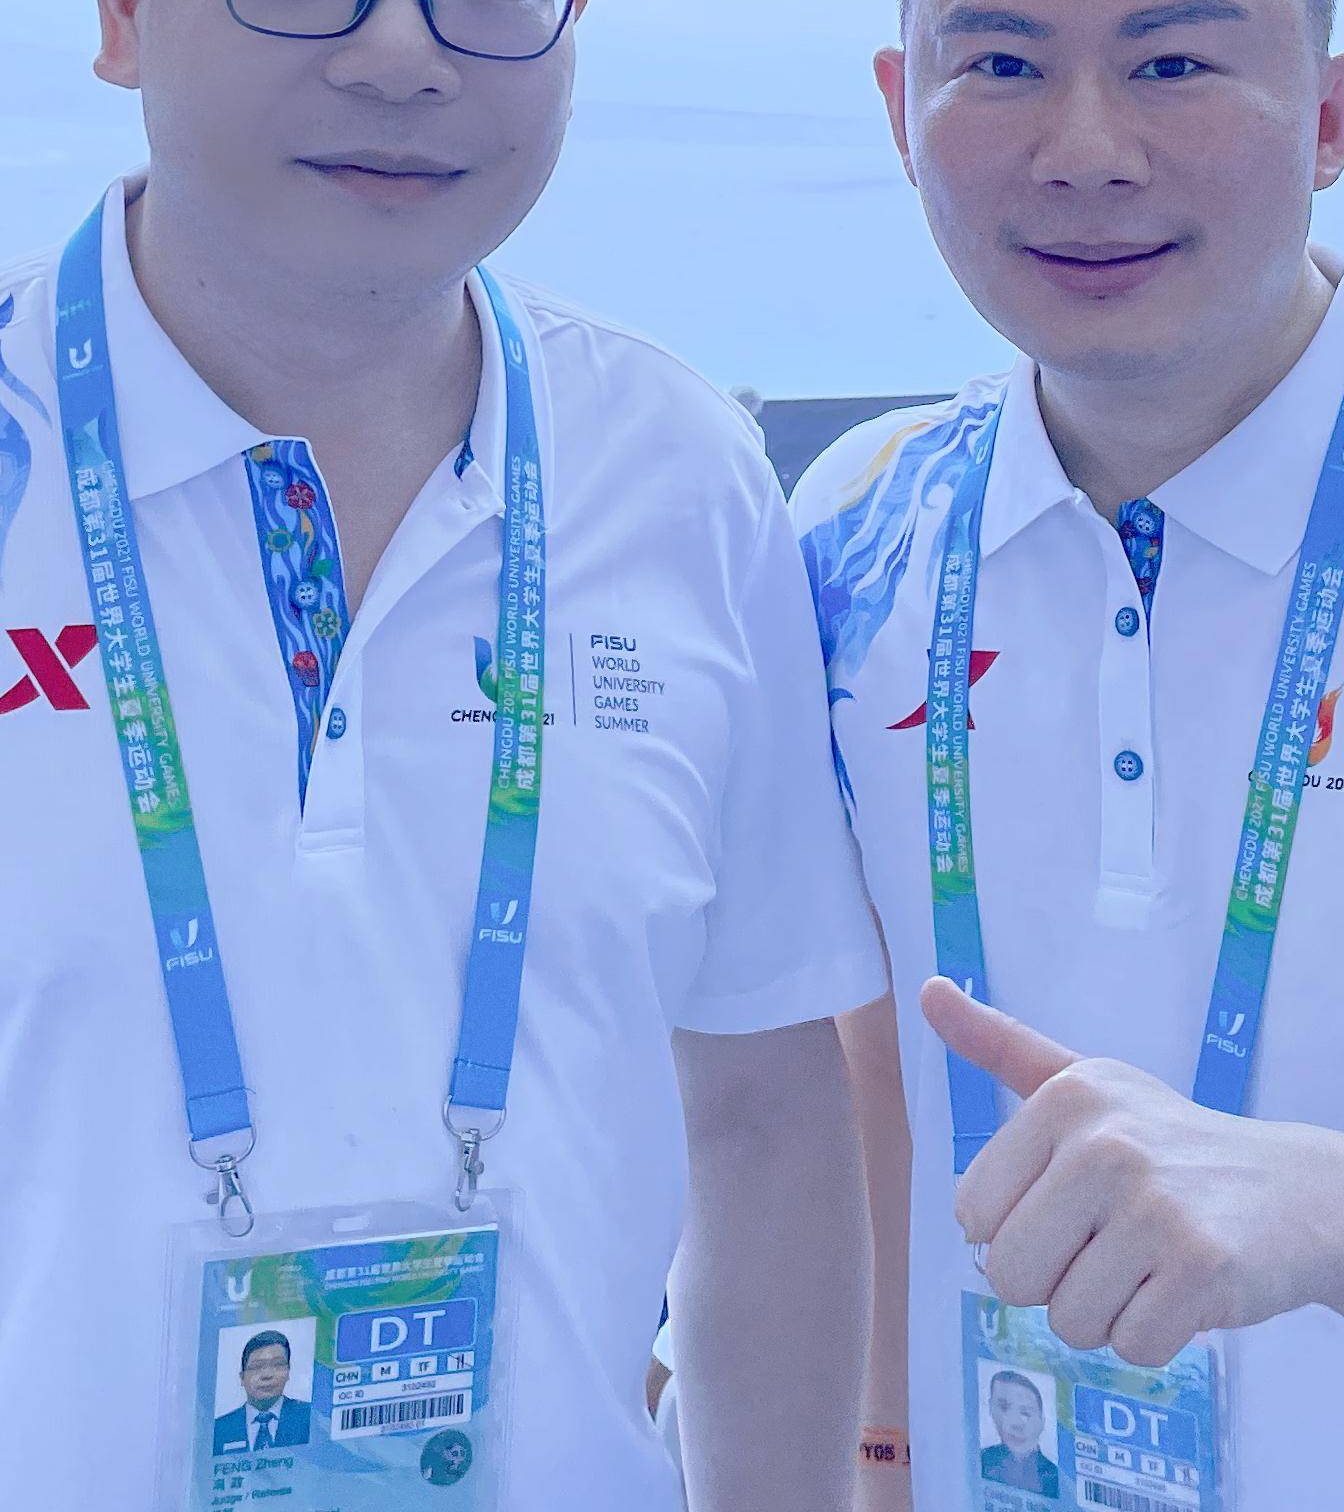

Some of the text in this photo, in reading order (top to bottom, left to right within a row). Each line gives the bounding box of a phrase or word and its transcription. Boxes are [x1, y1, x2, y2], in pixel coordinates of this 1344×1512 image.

[128, 602, 152, 657] WORLD
[498, 455, 522, 789] CHENGDU 2021 FISU WORLD UNIVERSITY GAMES
[590, 634, 637, 652] FISU
[591, 655, 641, 673] WORLD
[954, 647, 966, 676] FISU
[592, 675, 665, 695] UNIVERSITY
[139, 660, 170, 747] UNIVERSITY
[451, 709, 497, 723] CHEN
[594, 695, 639, 713] GAMES
[952, 680, 964, 731] WORLD
[594, 715, 649, 733] SUMMER
[1235, 828, 1260, 901] CHENGDU
[1262, 703, 1285, 756] WORLD
[1274, 615, 1306, 700] UNIVERSITY
[1296, 561, 1318, 612] GAMES
[158, 751, 183, 809] GAMES
[952, 735, 965, 818] UNIVERSITY
[478, 928, 523, 944] FISU
[166, 947, 213, 972] FISU
[1206, 1033, 1247, 1058] FISU
[370, 1309, 446, 1353] DT
[335, 1370, 359, 1384] CHN
[1103, 1399, 1169, 1446] DT
